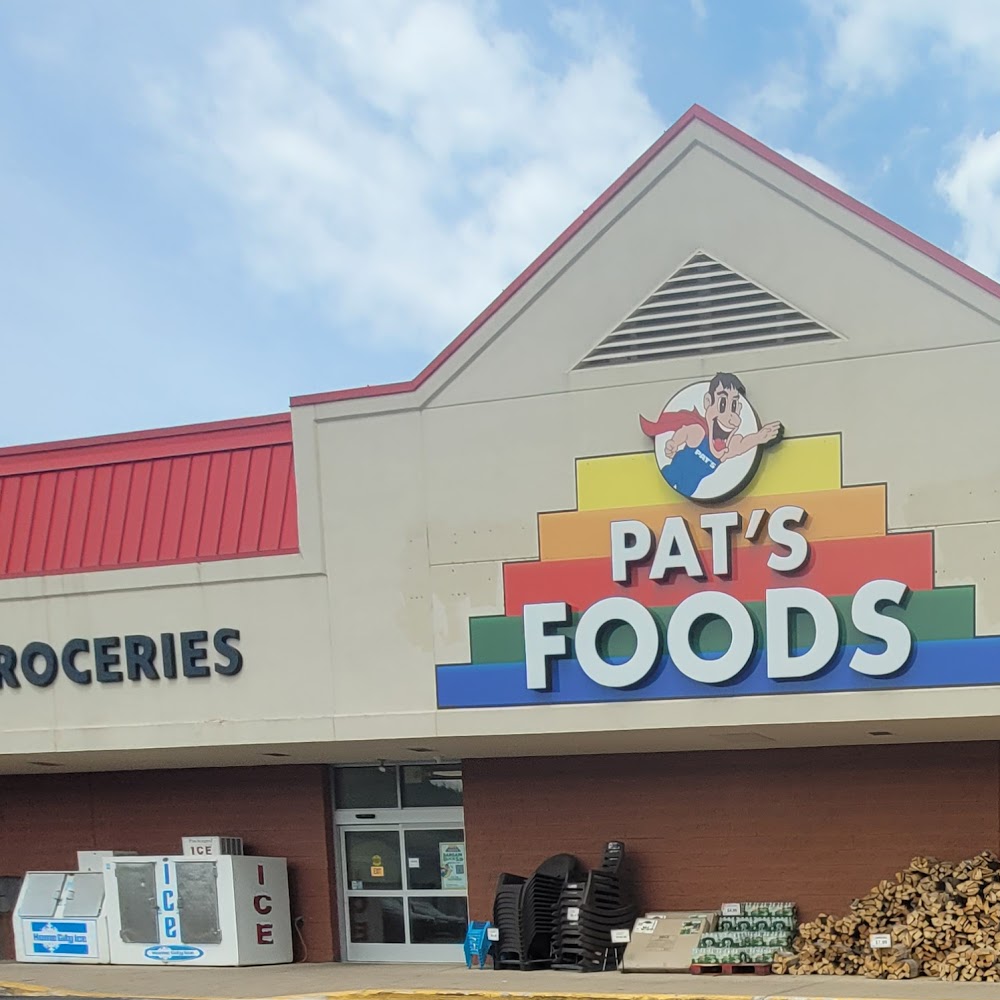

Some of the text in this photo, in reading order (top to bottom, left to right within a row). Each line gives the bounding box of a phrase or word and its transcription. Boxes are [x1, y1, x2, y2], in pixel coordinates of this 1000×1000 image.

[694, 448, 717, 470] PAT'S
[610, 505, 809, 585] PAT'S
[0, 627, 244, 689] ROCERIES
[523, 579, 912, 691] FOODS
[190, 846, 213, 856] ICE
[253, 864, 274, 945] ICE
